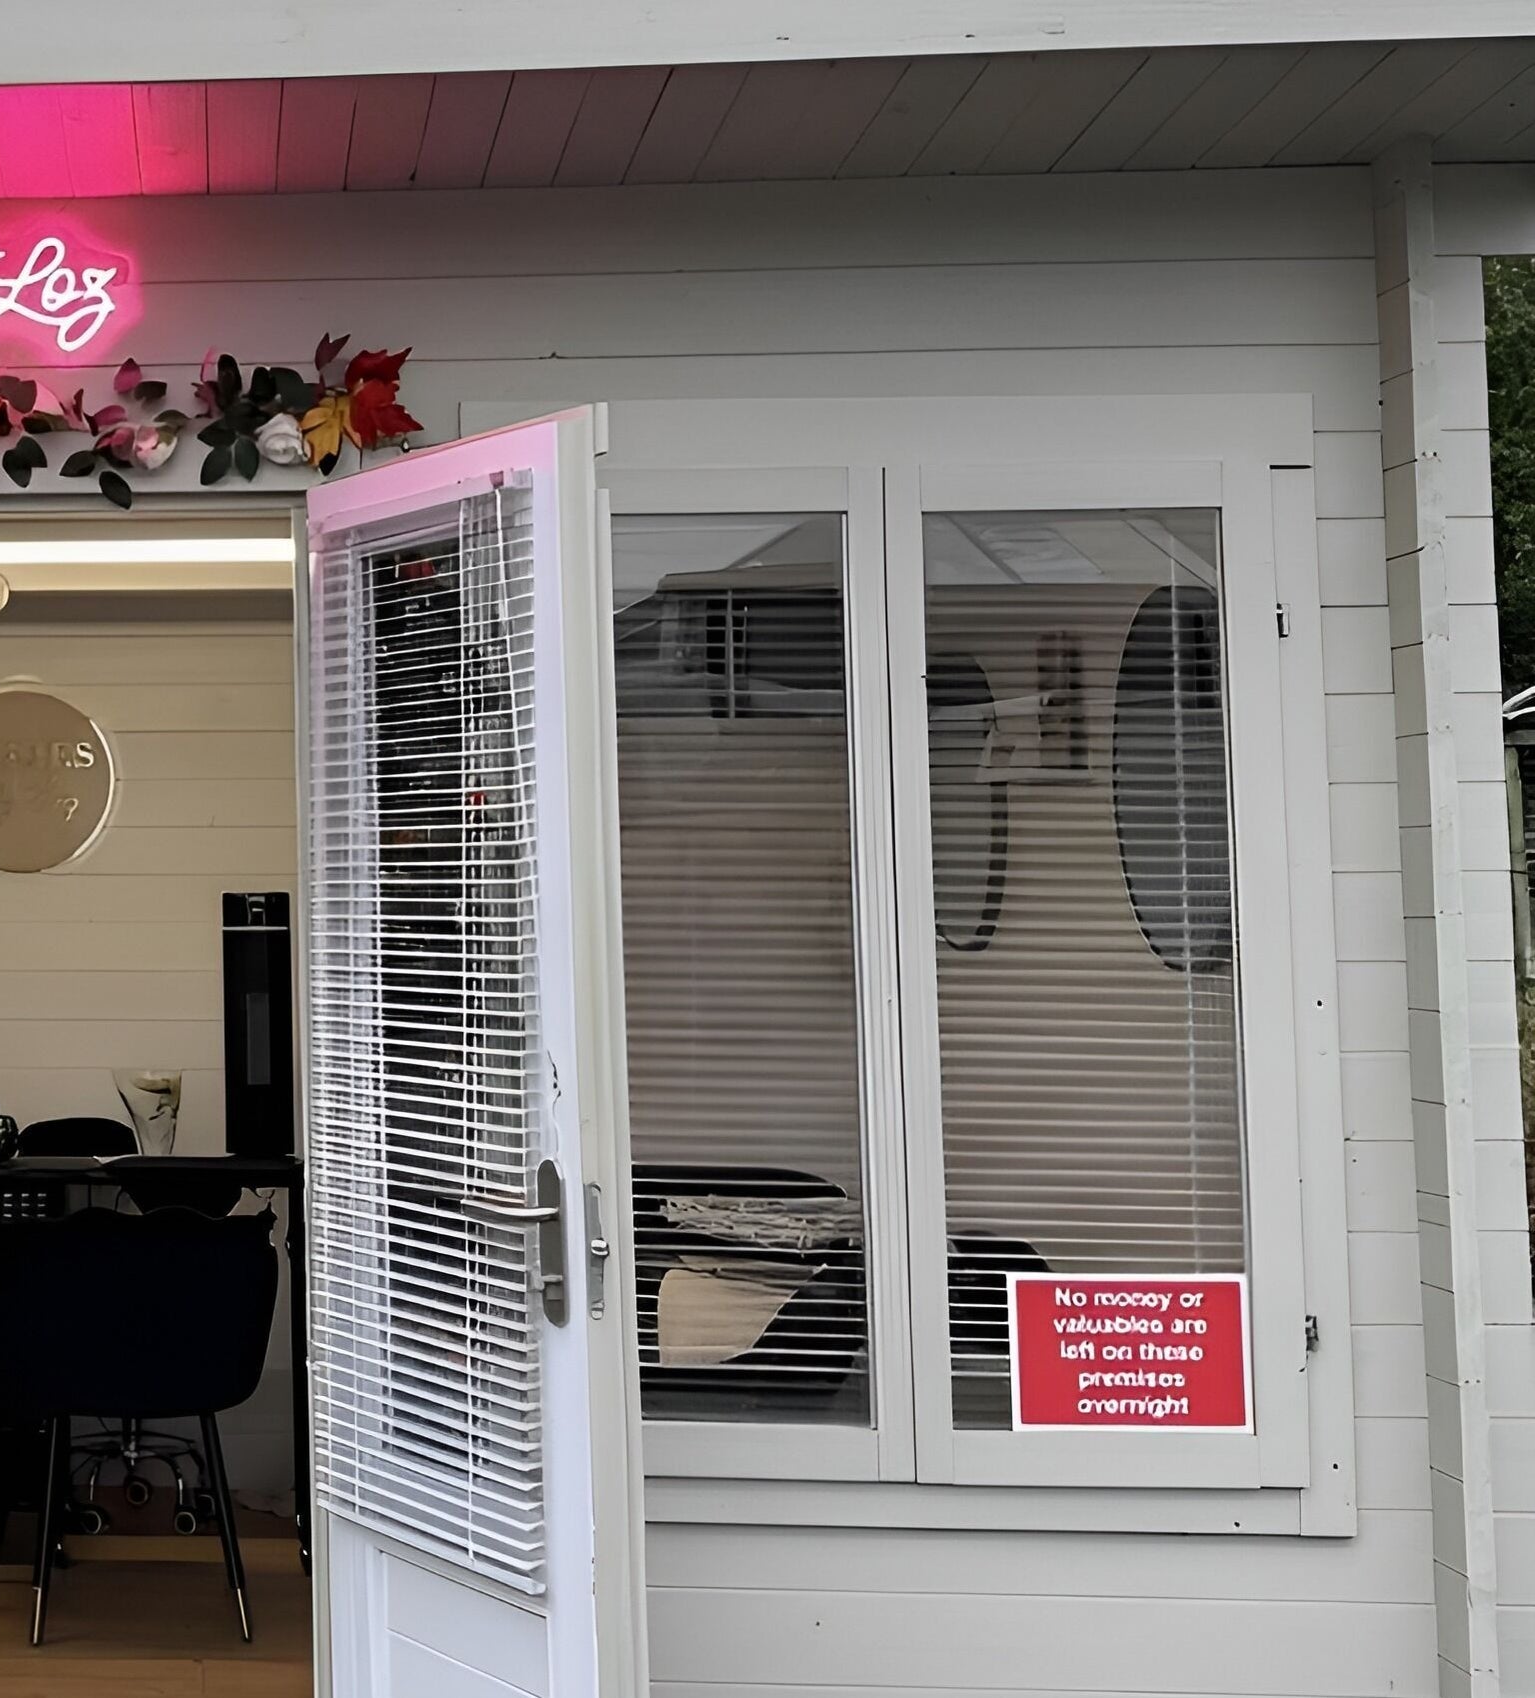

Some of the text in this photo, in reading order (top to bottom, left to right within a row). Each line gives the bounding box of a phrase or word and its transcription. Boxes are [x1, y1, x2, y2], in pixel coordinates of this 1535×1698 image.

[1054, 1287, 1087, 1307] No
[1179, 1292, 1204, 1307] or
[1060, 1340, 1095, 1360] left
[1102, 1344, 1132, 1360] on
